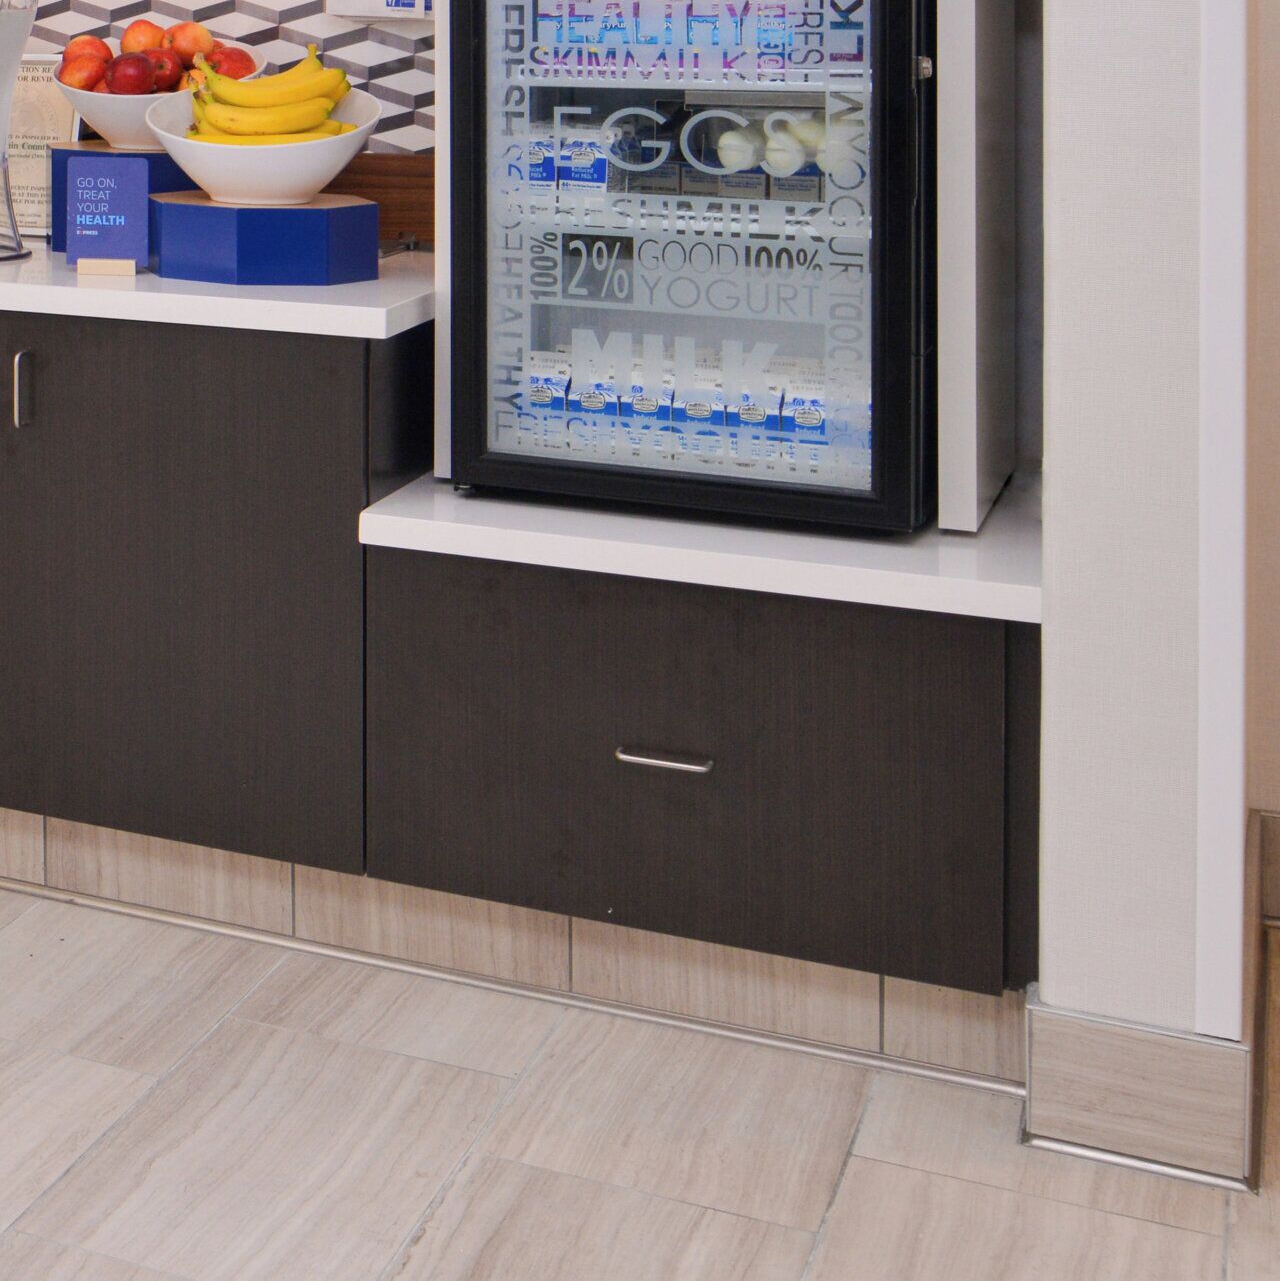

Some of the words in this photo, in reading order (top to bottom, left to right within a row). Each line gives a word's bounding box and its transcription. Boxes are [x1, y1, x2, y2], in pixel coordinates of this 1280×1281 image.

[21, 142, 45, 150] Count
[554, 106, 806, 178] EGGS
[77, 178, 94, 188] GO
[97, 178, 117, 189] ON,
[77, 190, 111, 200] TREAT
[76, 215, 125, 226] HEALTH
[77, 202, 109, 213] YOUR
[676, 200, 826, 242] MILK
[529, 232, 558, 300] 100%
[567, 239, 630, 299] 2%
[638, 238, 739, 276] GOOD
[744, 245, 825, 280] 100%
[639, 274, 822, 317] YOGURT
[572, 328, 782, 405] MILK
